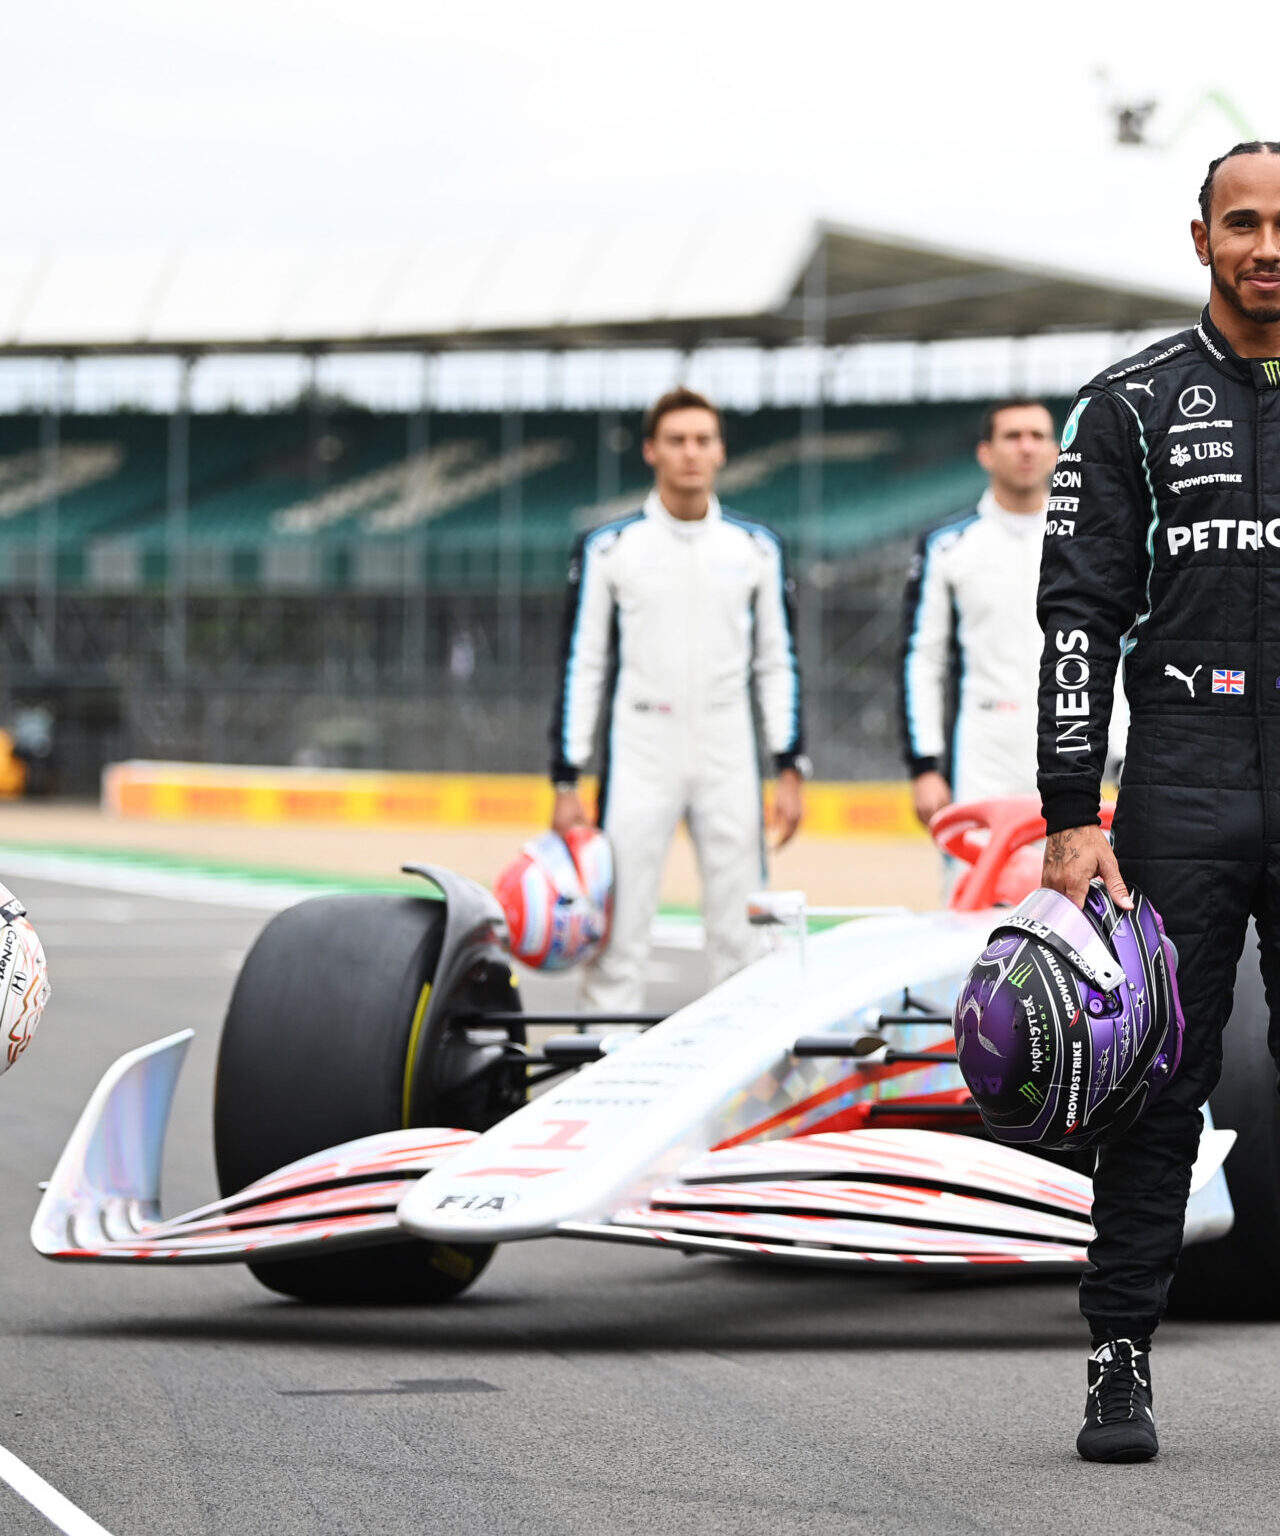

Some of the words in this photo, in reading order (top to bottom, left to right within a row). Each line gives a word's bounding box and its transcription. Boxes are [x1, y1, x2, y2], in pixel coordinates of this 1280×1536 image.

[1193, 442, 1234, 460] UBS
[1052, 470, 1082, 488] SON
[1171, 473, 1243, 489] CROWDSTRIKE
[1056, 629, 1091, 754] INEOS
[1022, 995, 1043, 1072] MONSTER
[1066, 1041, 1082, 1128] CROWDSTRIKE
[511, 1120, 592, 1150] 1
